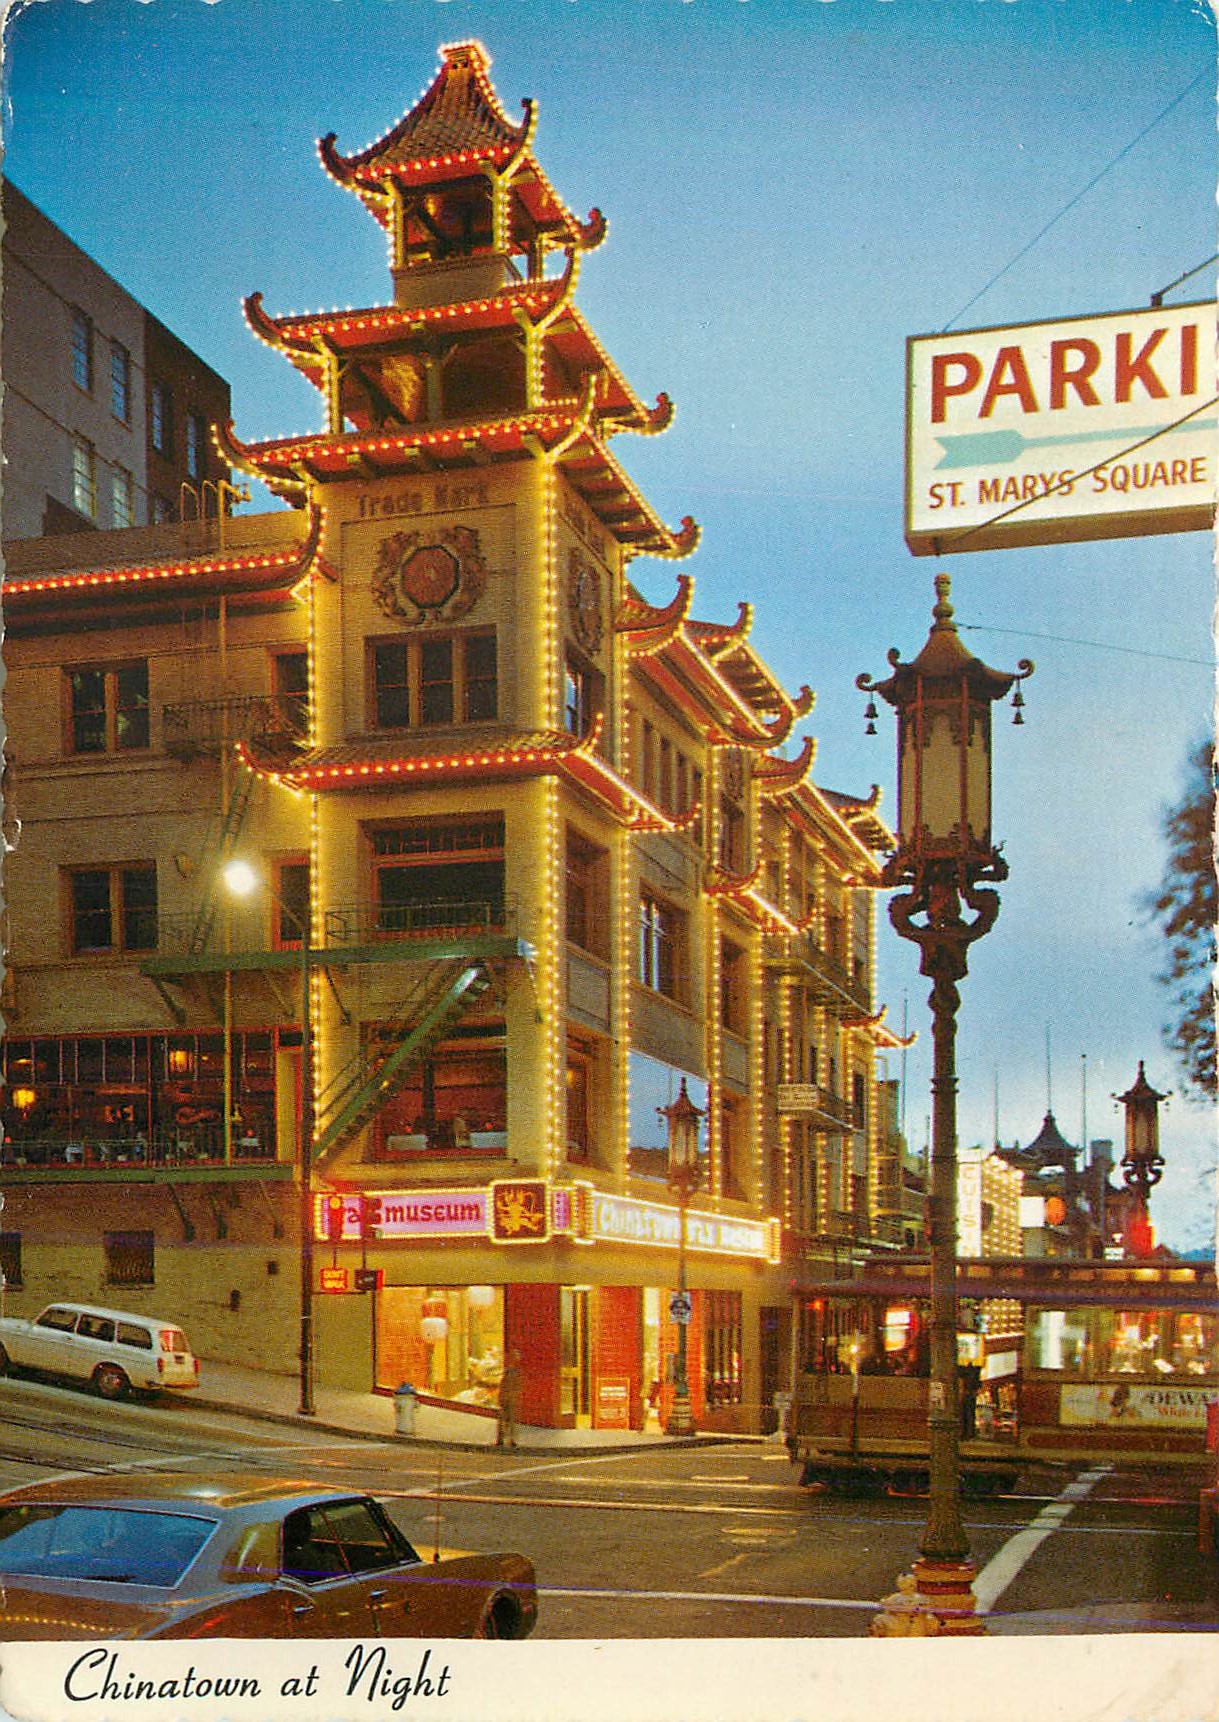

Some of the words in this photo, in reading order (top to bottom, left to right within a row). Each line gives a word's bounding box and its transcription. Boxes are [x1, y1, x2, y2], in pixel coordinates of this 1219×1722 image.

[930, 324, 1198, 424] PARKI
[929, 481, 966, 510] ST.
[978, 469, 1075, 505] MARYS
[1091, 456, 1208, 495] SQUARE
[385, 1203, 481, 1224] museum
